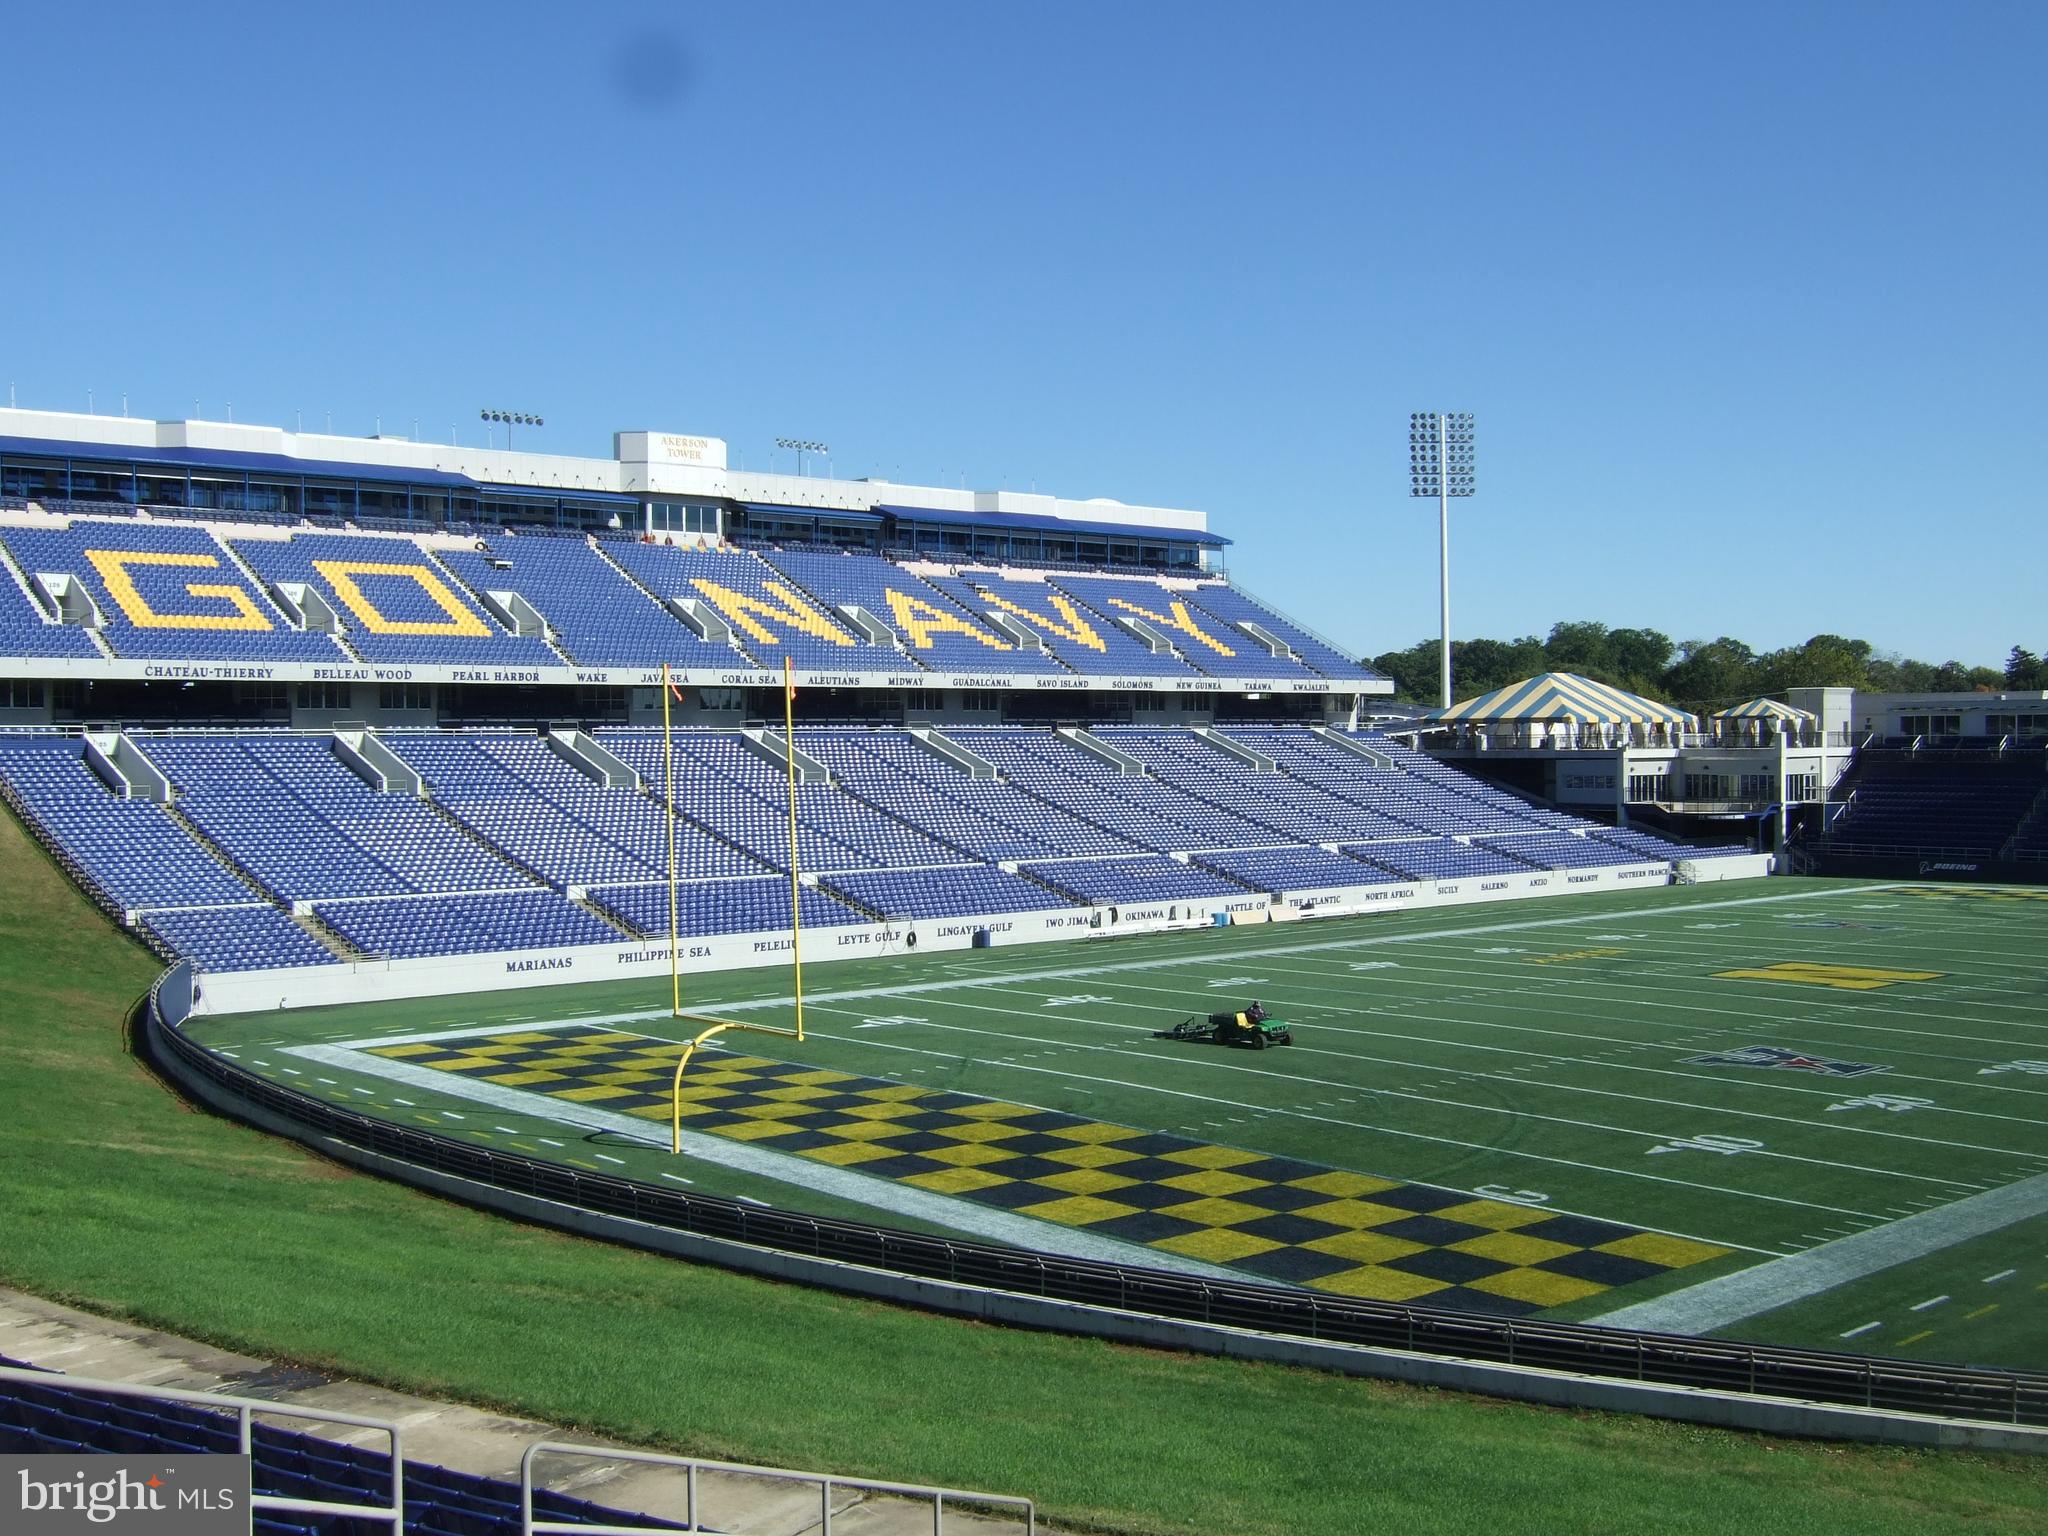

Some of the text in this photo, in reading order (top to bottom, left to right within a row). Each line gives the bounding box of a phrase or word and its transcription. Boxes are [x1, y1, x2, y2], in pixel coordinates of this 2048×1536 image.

[661, 436, 708, 449] AKERSON
[667, 448, 701, 460] TOWER
[145, 665, 274, 679] CHATEAU-THIERRY
[313, 669, 412, 680] BELLEAU WOOD
[452, 671, 540, 682] PEARL HARBOR
[576, 673, 608, 683] WAKE
[670, 674, 690, 684] SEA
[721, 675, 777, 685] CORAL SEA
[808, 676, 860, 686] ALEUTIANS
[888, 677, 924, 687] MIDWAY
[952, 678, 1013, 688] GUADALCANAL
[1036, 679, 1090, 689] SAVO ISLAND
[1112, 680, 1154, 690] SOLOMONS
[1176, 681, 1222, 691] NEW GUINEA
[1244, 682, 1272, 691] TARAWA
[1567, 874, 1599, 884] NORMANDY
[1617, 871, 1646, 880] SOUTHERN
[1481, 882, 1509, 891] SALERNO
[1530, 878, 1548, 887] ANZIO
[1365, 889, 1414, 901] NORTH AFRICA
[1437, 886, 1459, 895] SICILY
[1225, 903, 1253, 913] BATTLE
[1256, 901, 1266, 911] OF
[1305, 895, 1341, 905] ATLANTIC
[1125, 910, 1164, 921] OKINAWA
[1046, 915, 1089, 928] IWO JIMA
[989, 922, 1013, 933] GULF
[838, 931, 901, 945] LEYTE GULF
[689, 946, 711, 957] SEA
[506, 957, 572, 972] MARIANAS
